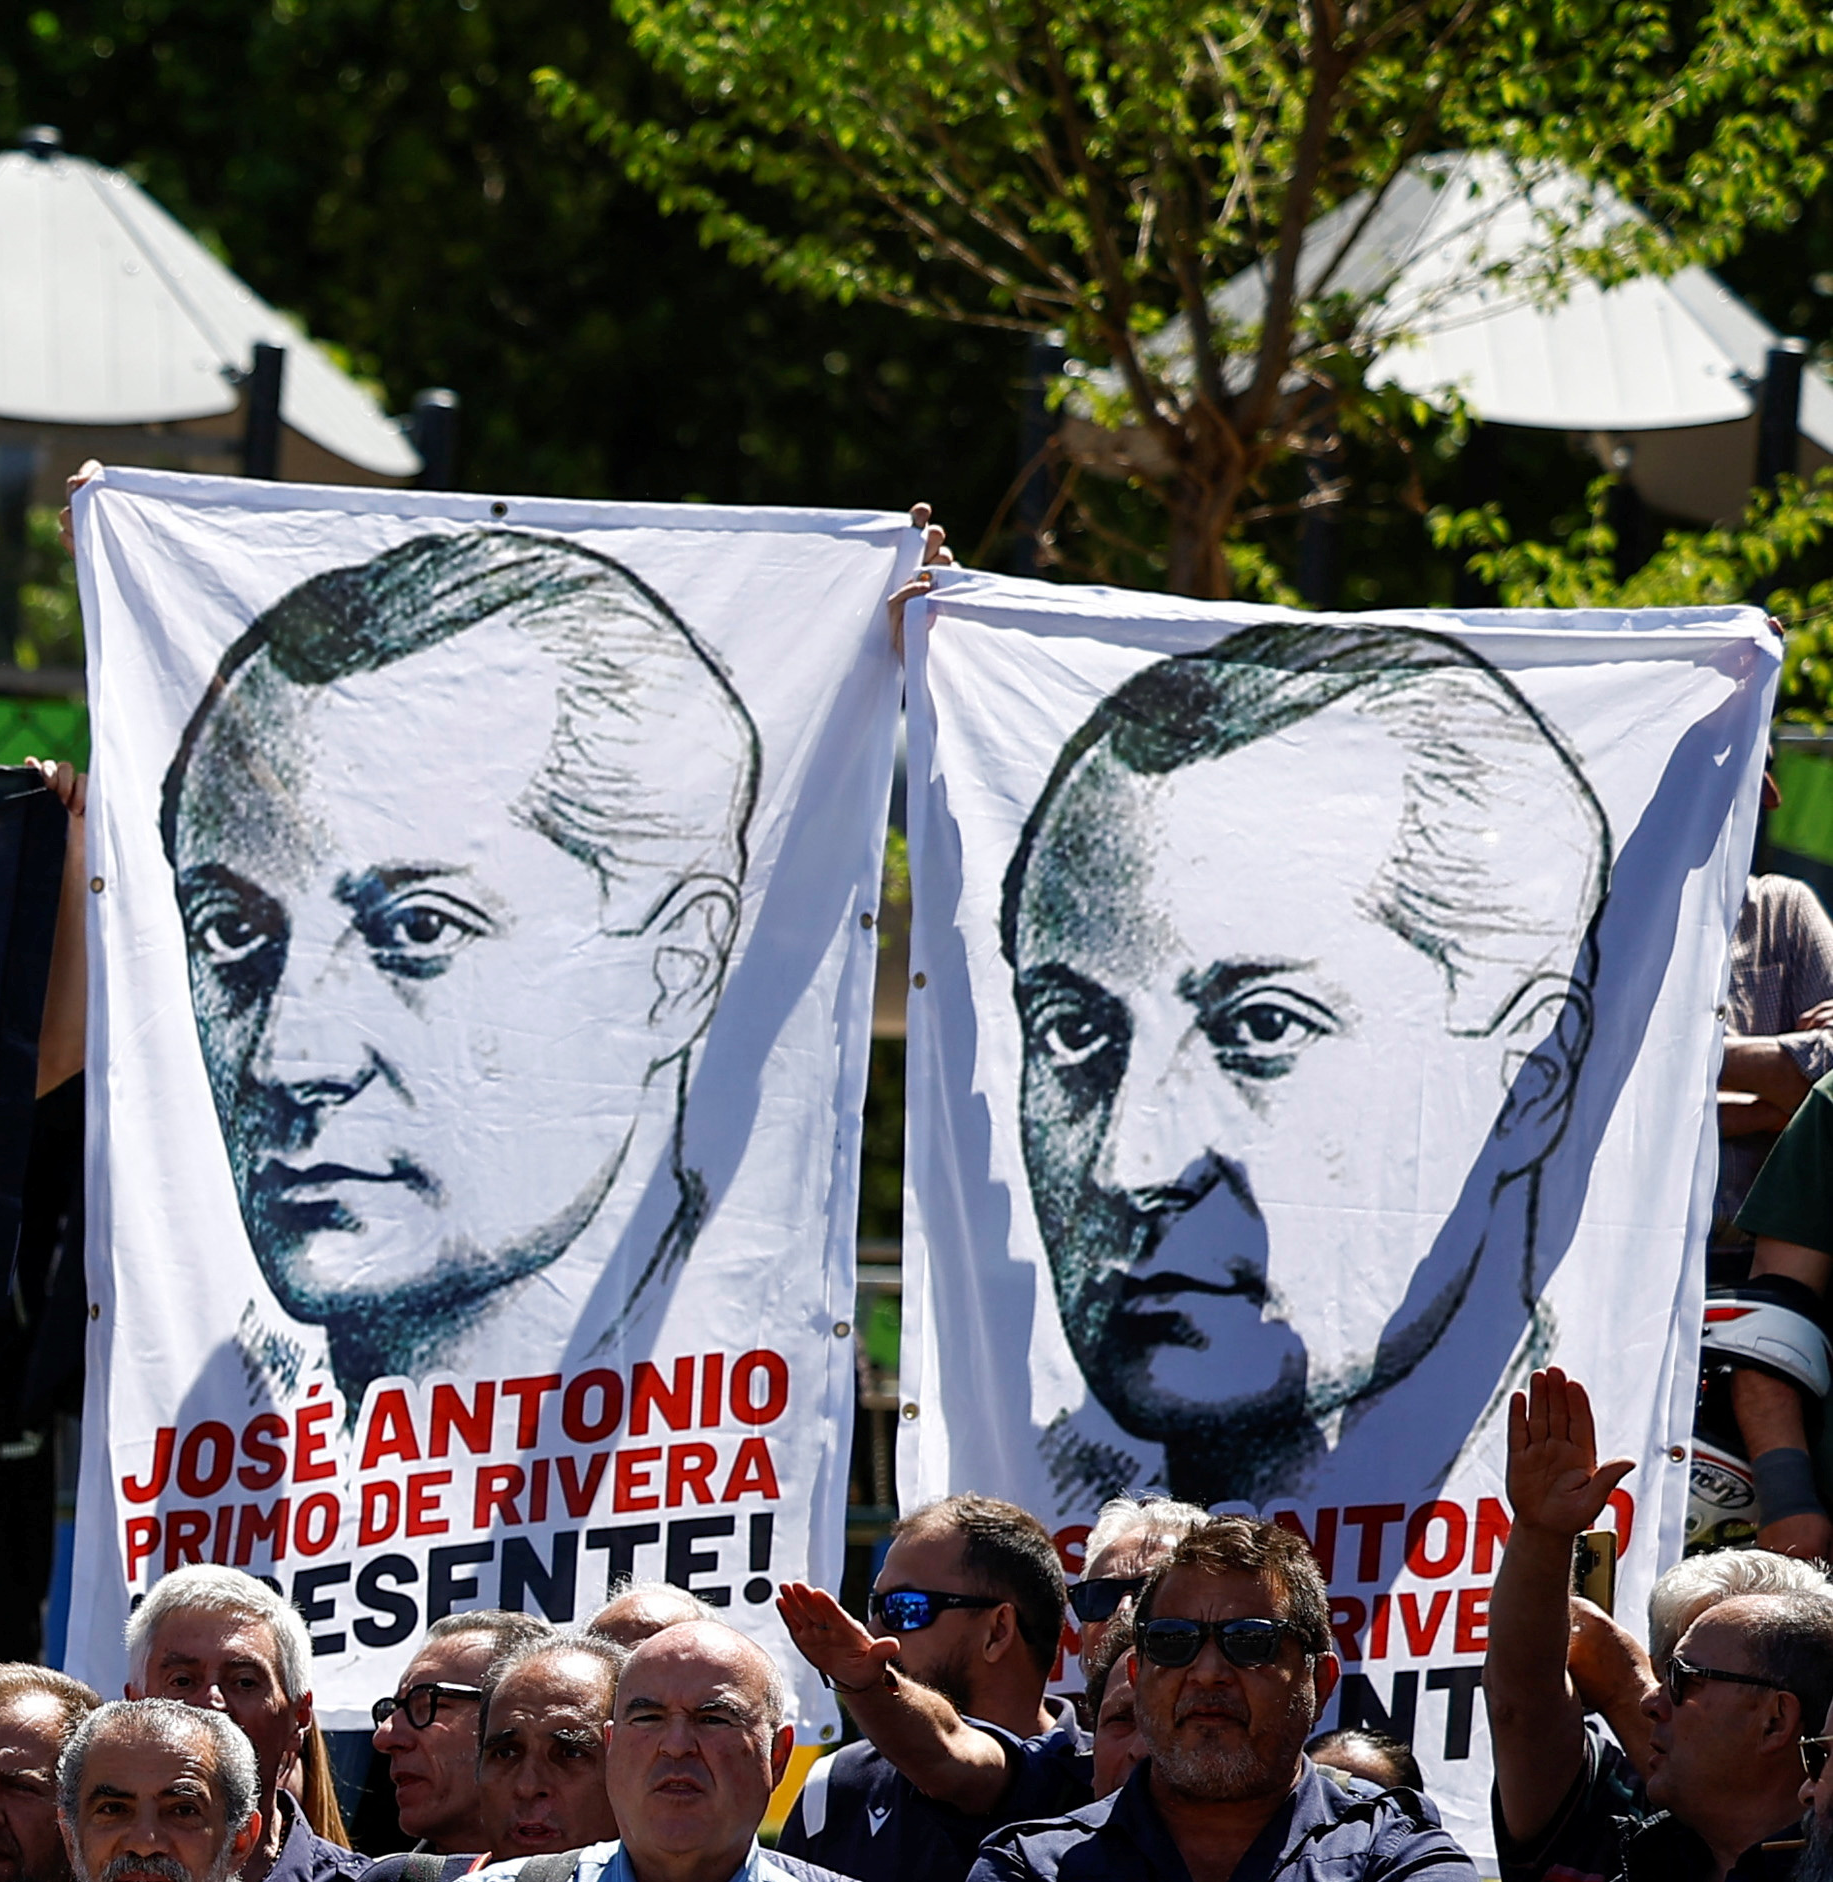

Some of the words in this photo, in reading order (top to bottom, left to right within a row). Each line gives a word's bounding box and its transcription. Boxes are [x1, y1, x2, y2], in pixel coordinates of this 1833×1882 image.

[121, 1382, 336, 1505] JOSÉ
[359, 1349, 790, 1471] ANTONIO
[125, 1491, 341, 1583] PRIMO
[357, 1471, 452, 1547] DE
[473, 1436, 781, 1528] RIVERA
[131, 1511, 774, 1658] ESENTE!
[1328, 1586, 1492, 1663] RIVE
